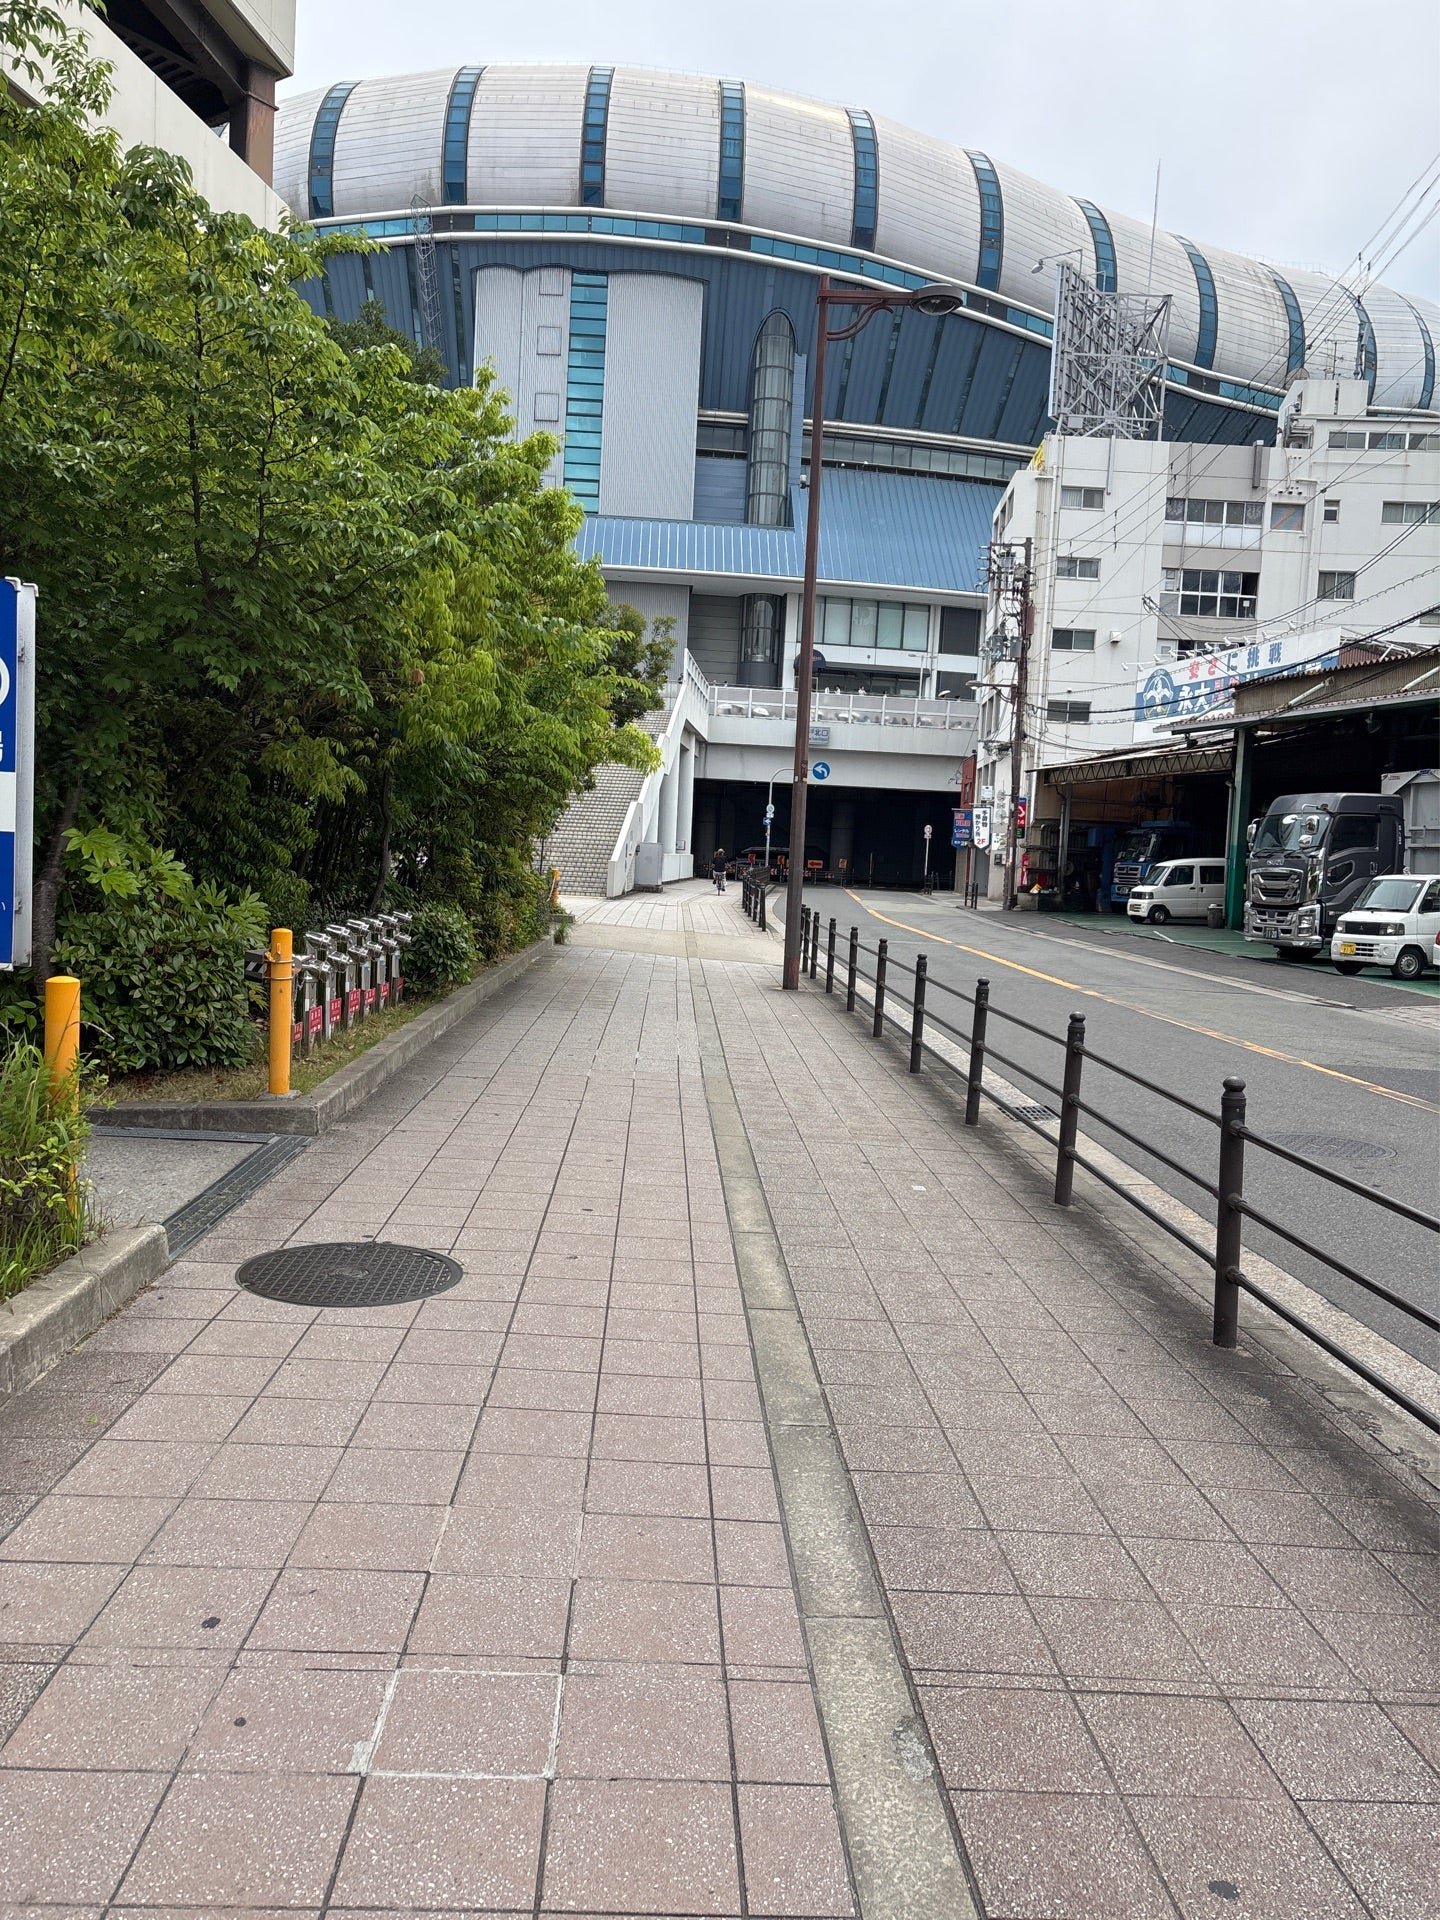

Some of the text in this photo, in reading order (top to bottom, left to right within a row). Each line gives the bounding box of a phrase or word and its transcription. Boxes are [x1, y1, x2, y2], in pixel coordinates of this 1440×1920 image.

[1187, 642, 1283, 680] 安さに挑戦
